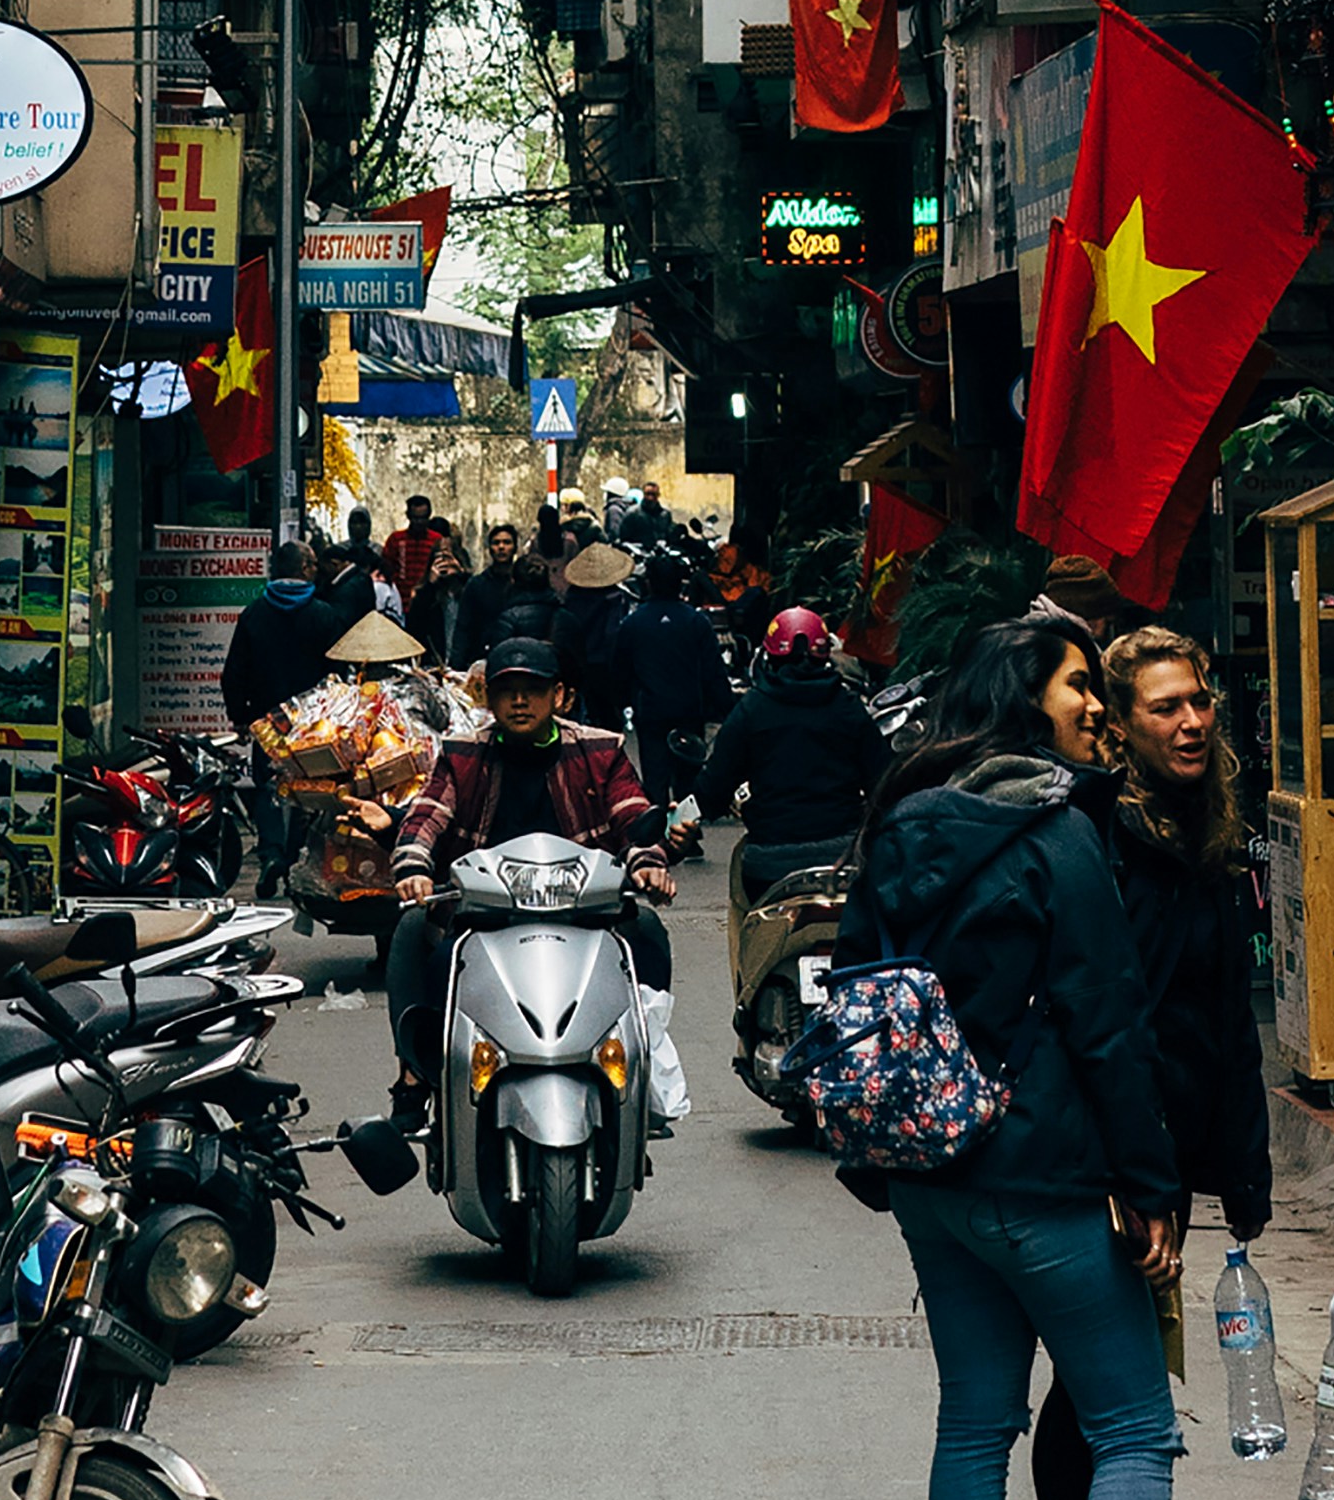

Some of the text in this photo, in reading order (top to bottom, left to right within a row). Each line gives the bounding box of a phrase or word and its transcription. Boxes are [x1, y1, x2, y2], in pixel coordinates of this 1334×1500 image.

[26, 102, 81, 130] Tour
[3, 141, 53, 158] belief
[396, 234, 416, 260] 51
[787, 227, 840, 260] Spa
[161, 273, 212, 302] CITY
[298, 271, 415, 305] NHÀ NGHỈ 51
[159, 532, 210, 550] MONEY
[139, 557, 264, 577] MONEY EXCHANGE
[190, 613, 212, 624] BAY
